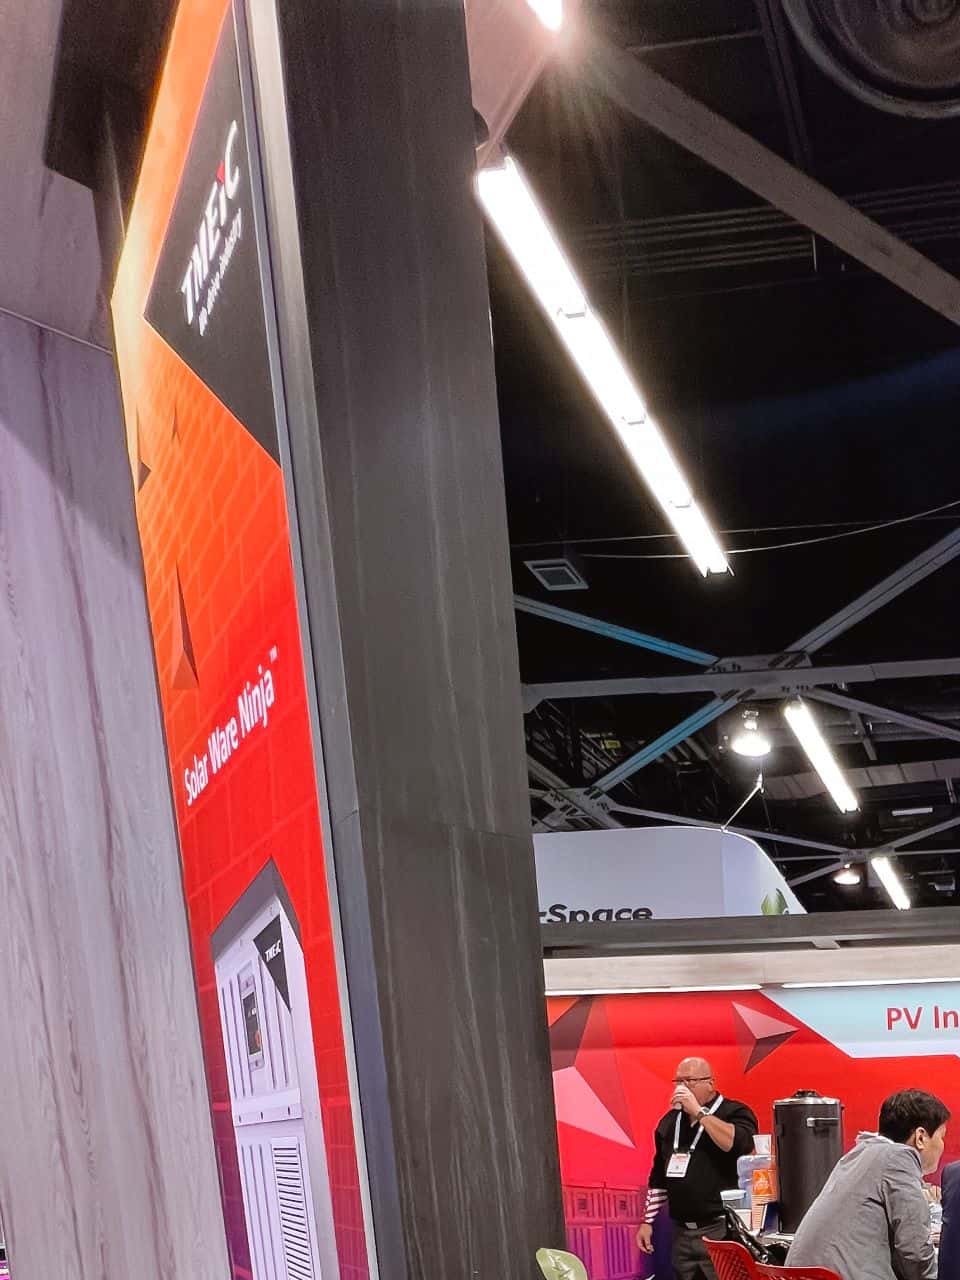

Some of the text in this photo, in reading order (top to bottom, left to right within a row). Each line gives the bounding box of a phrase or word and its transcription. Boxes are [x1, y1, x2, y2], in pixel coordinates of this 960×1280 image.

[184, 754, 209, 807] Solar
[208, 717, 239, 775] Ware
[887, 1006, 923, 1031] PV
